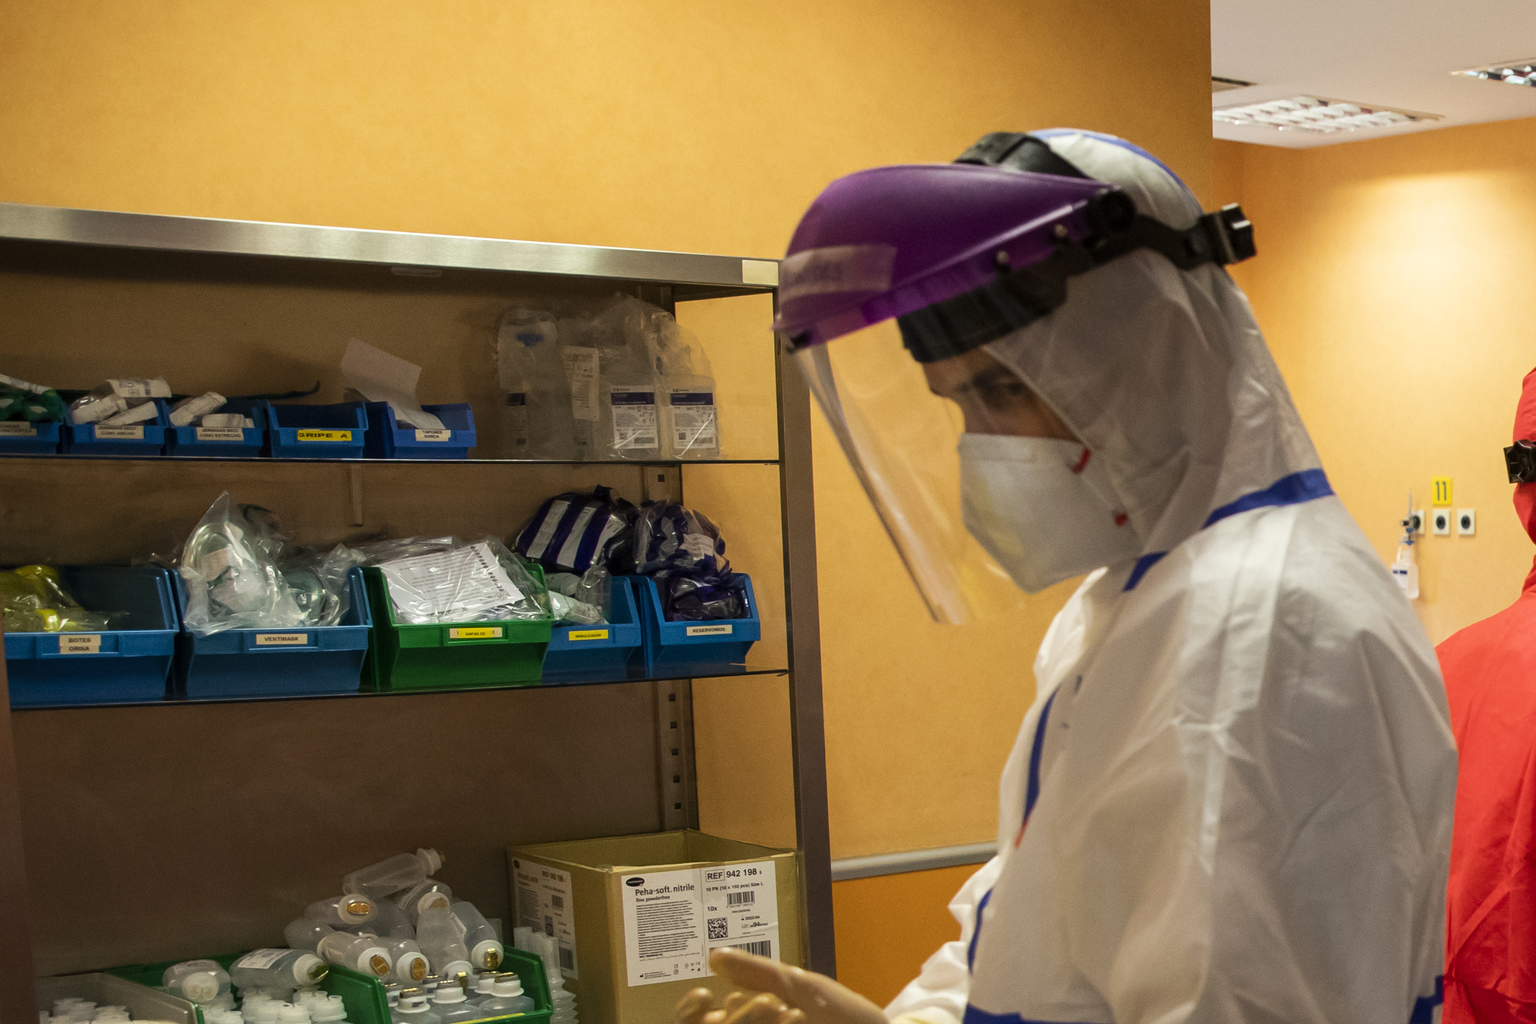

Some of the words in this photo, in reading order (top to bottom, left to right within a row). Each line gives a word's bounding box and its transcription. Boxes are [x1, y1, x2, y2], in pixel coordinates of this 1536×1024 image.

[1435, 481, 1447, 501] 11
[707, 872, 723, 880] REF
[726, 870, 741, 878] 942
[743, 868, 757, 876] 198
[673, 883, 695, 892] nitrile
